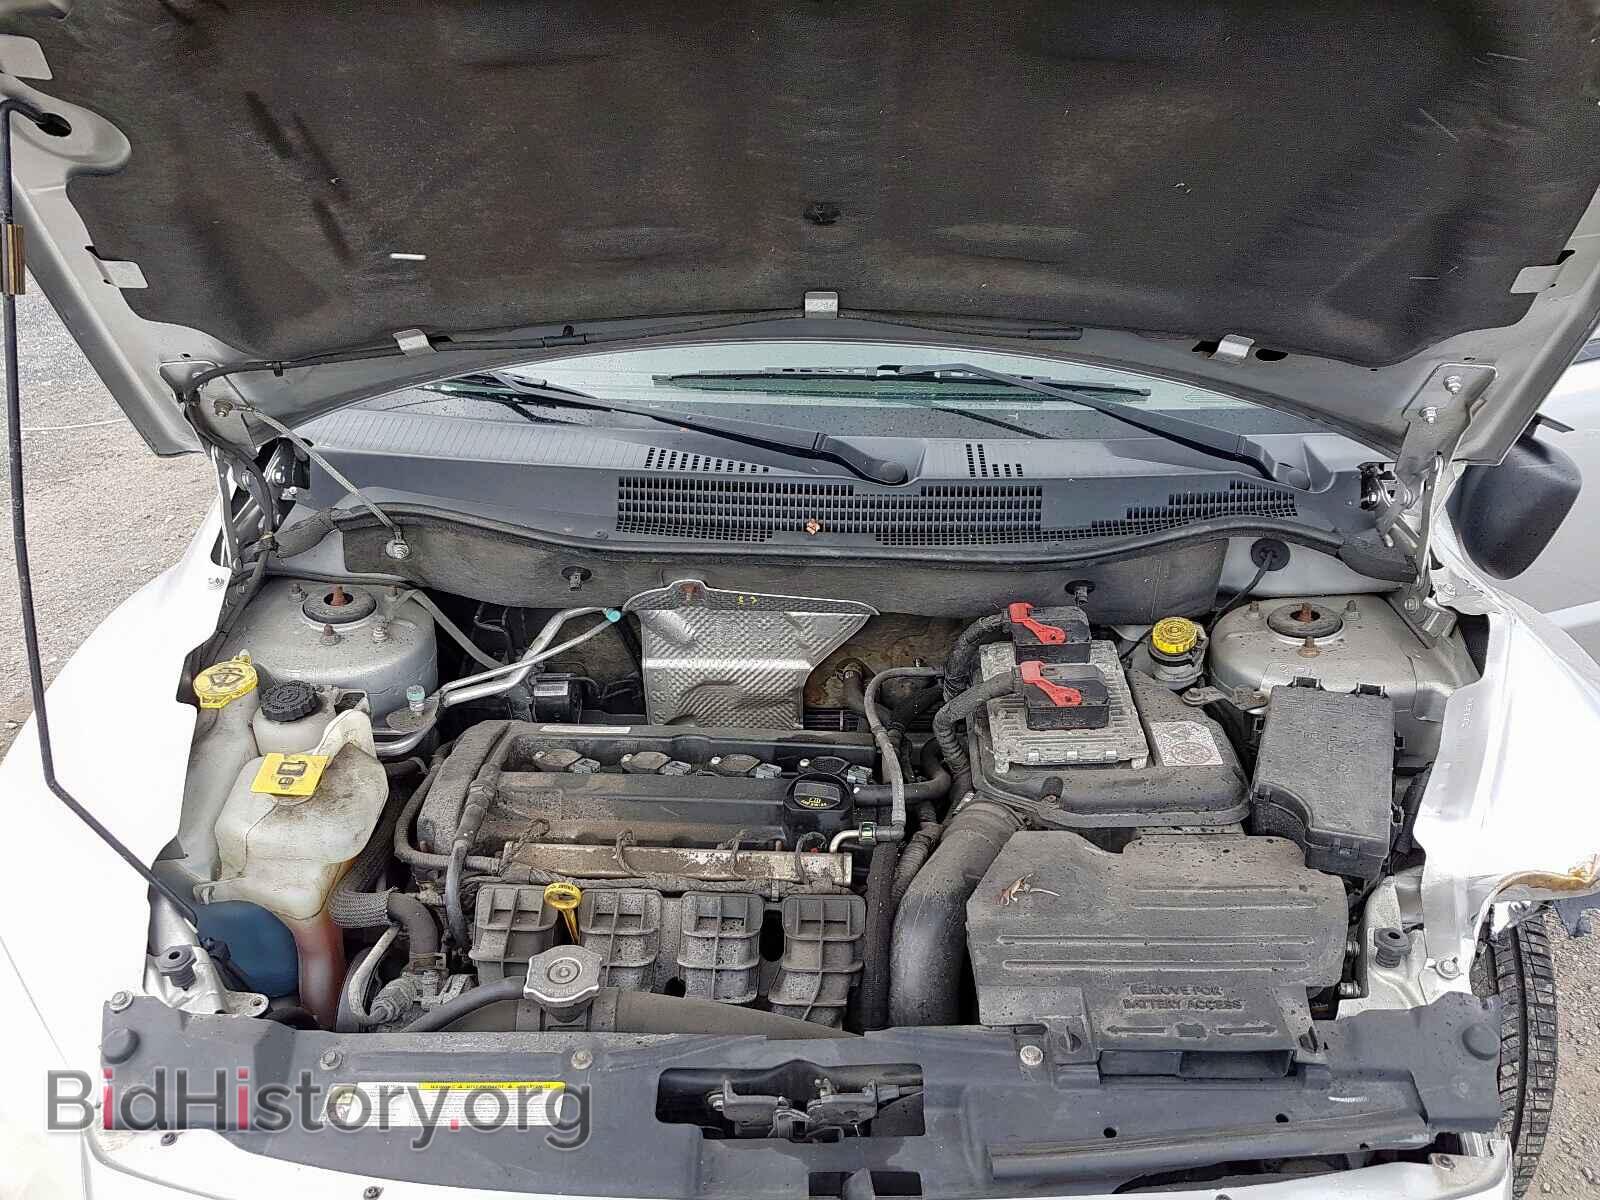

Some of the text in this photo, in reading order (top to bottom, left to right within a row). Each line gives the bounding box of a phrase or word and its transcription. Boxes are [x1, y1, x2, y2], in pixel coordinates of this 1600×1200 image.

[1130, 985, 1223, 997] REMOVE FOR
[1123, 999, 1243, 1010] BATTERY ACCESS
